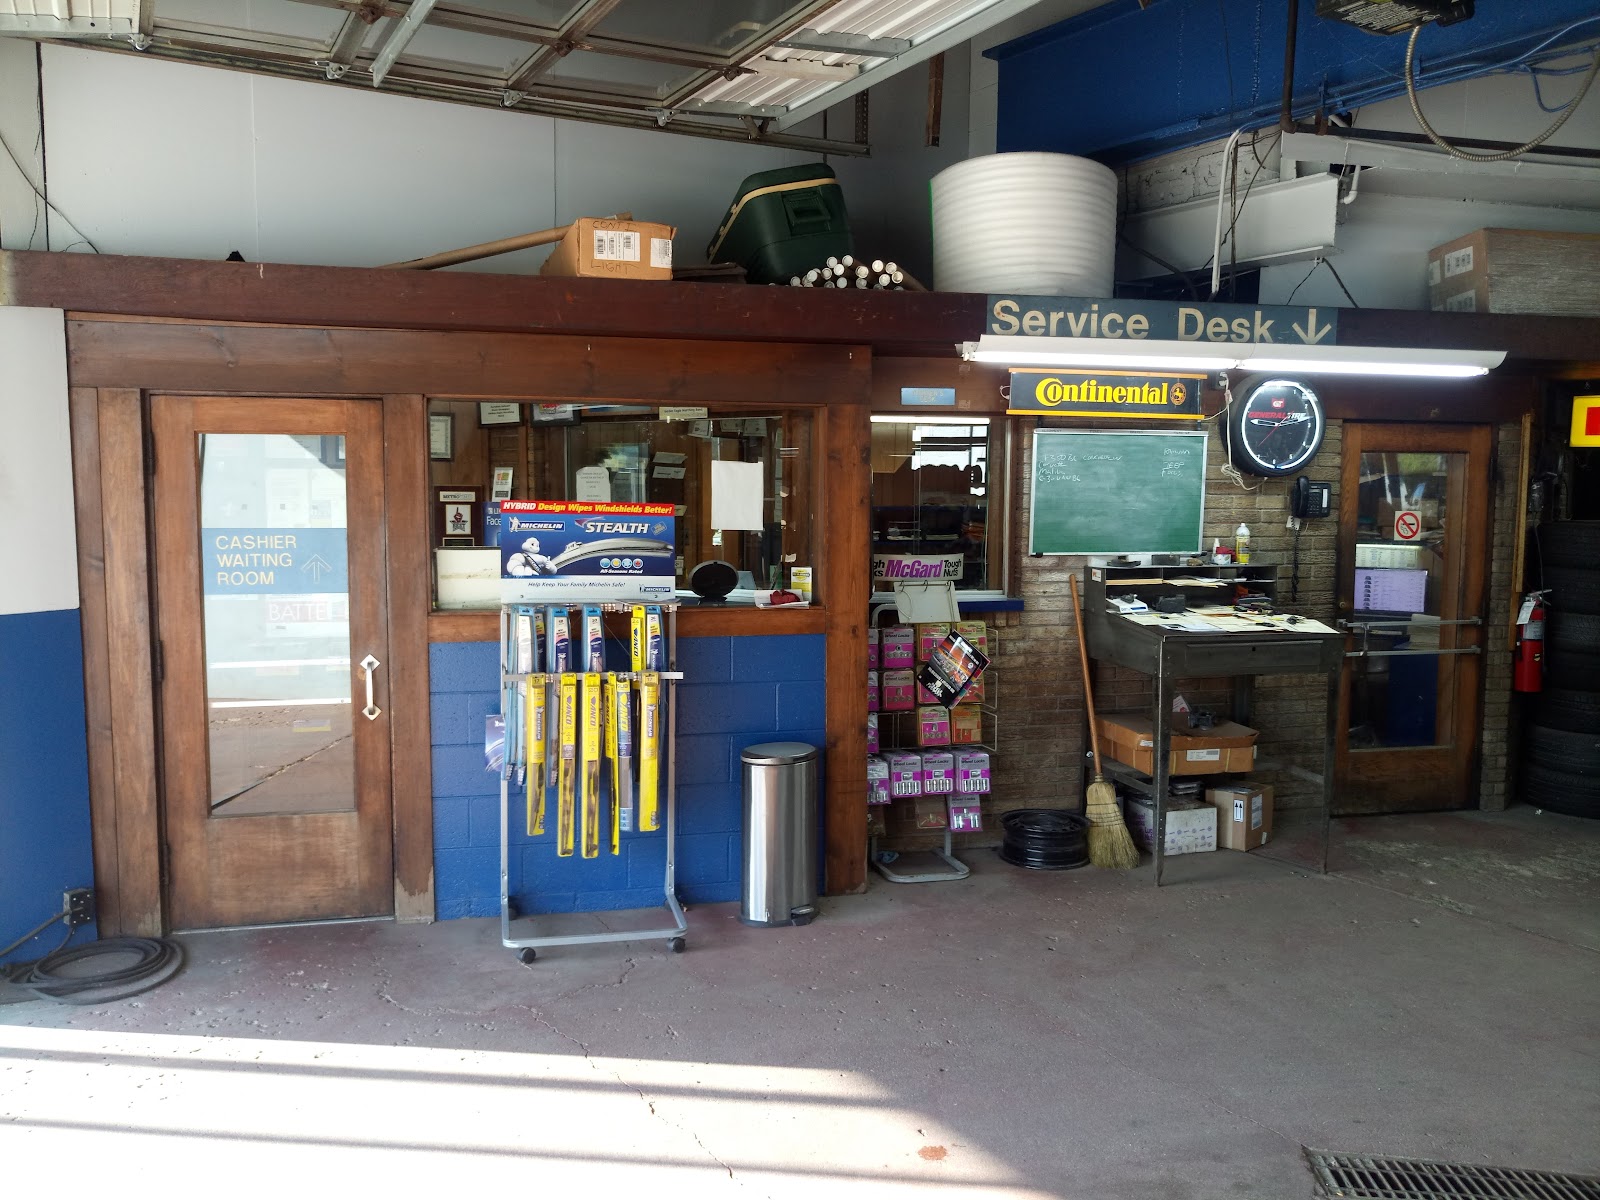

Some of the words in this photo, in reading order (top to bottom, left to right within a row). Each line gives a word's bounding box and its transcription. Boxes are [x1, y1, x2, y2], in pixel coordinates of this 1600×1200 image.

[592, 220, 636, 232] CONTI
[991, 299, 1150, 340] Service
[1177, 307, 1275, 343] Desk
[1035, 377, 1168, 407] Continental
[1247, 411, 1287, 419] GENERAL
[502, 501, 537, 510] HYBRID
[537, 502, 566, 512] Design
[567, 503, 593, 513] Wipes
[594, 504, 643, 514] Windshields
[644, 505, 672, 514] Better!
[520, 522, 564, 530] MICHELIN
[585, 521, 650, 534] STEALTH
[215, 534, 297, 550] CASHIER
[216, 552, 293, 567] WAITING
[943, 559, 962, 569] Tough
[884, 559, 944, 578] McGard
[943, 568, 959, 577] Nuts
[217, 571, 275, 586] ROOM
[565, 701, 573, 725] ANCO
[589, 702, 597, 726] ANCO
